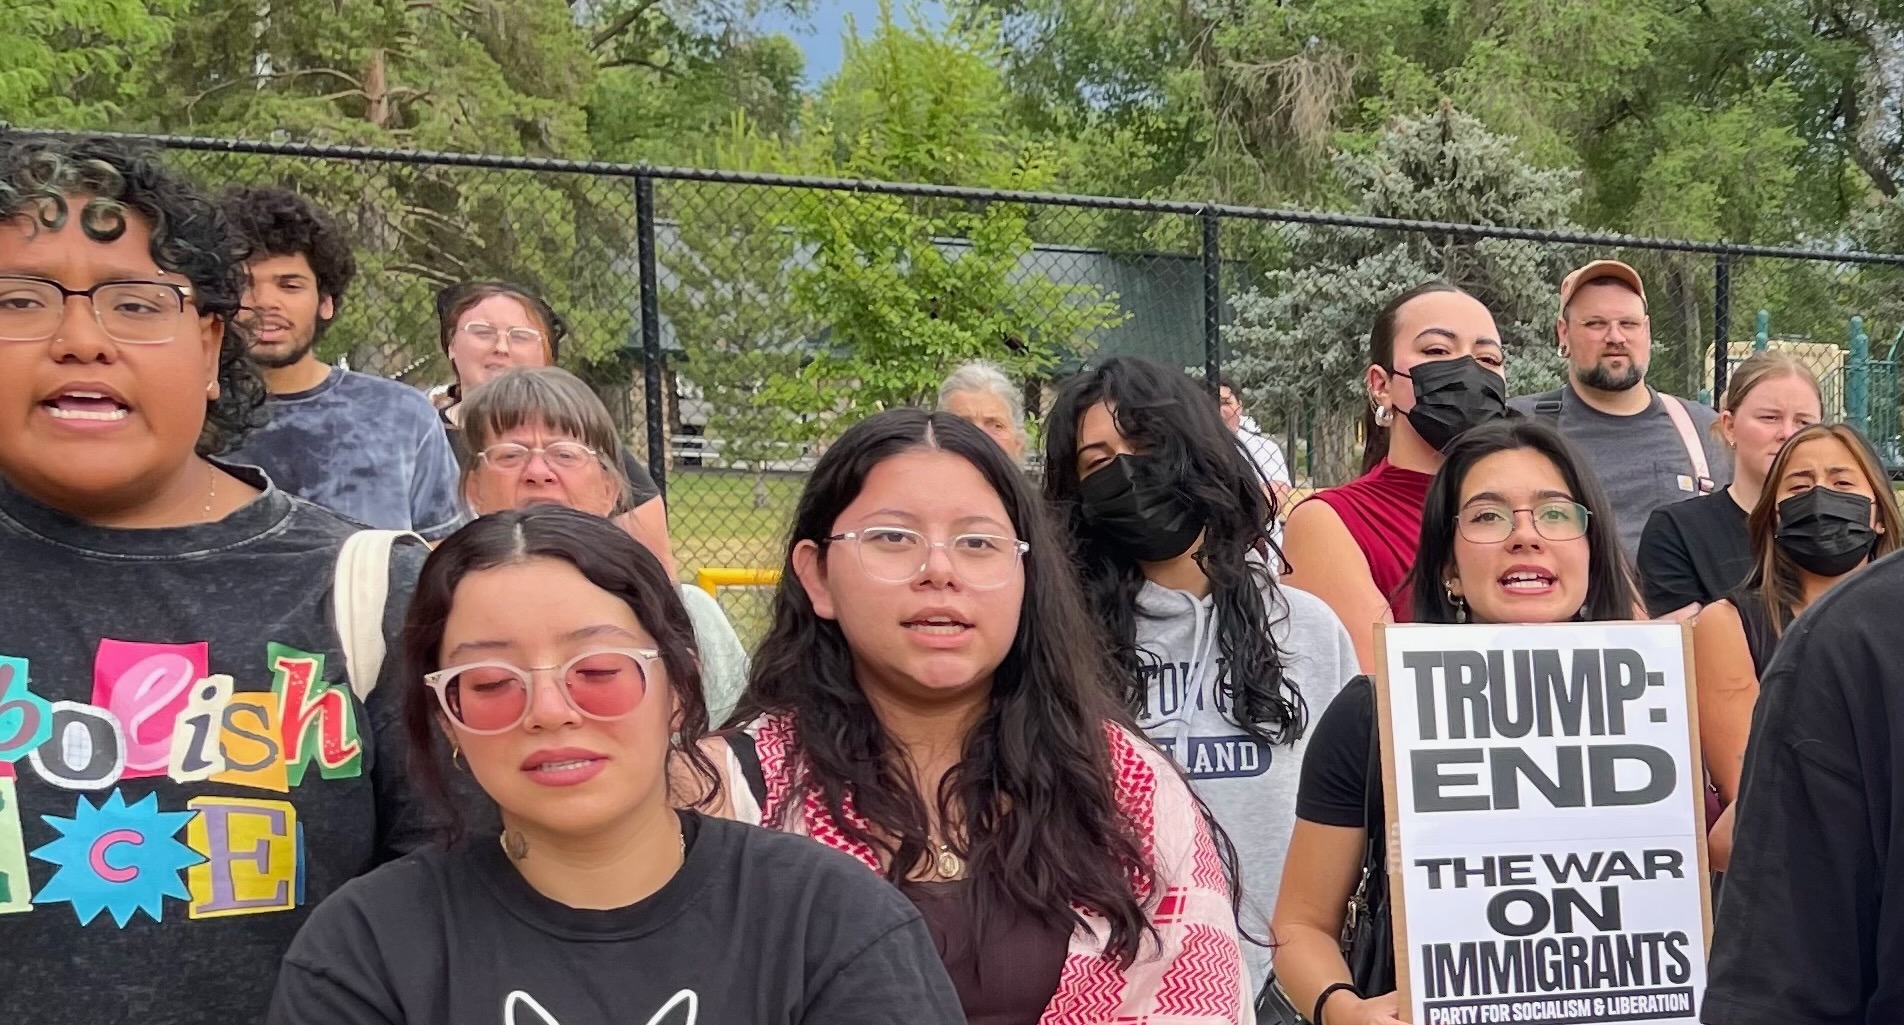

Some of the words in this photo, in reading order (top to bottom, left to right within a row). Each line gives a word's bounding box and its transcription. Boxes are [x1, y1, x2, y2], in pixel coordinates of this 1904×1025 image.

[1403, 649, 1667, 740] TRUMP:
[1410, 744, 1676, 813] END
[0, 788, 290, 913] CE
[1415, 853, 1535, 889] THE
[1540, 849, 1683, 883] WAR
[1487, 886, 1622, 935] ON
[1422, 931, 1691, 999] IMMIGRANTS
[1481, 1002, 1511, 1023] FOR
[1512, 997, 1591, 1021] SOCIALISM
[1593, 997, 1605, 1017] &
[1608, 993, 1690, 1016] LIBERATION
